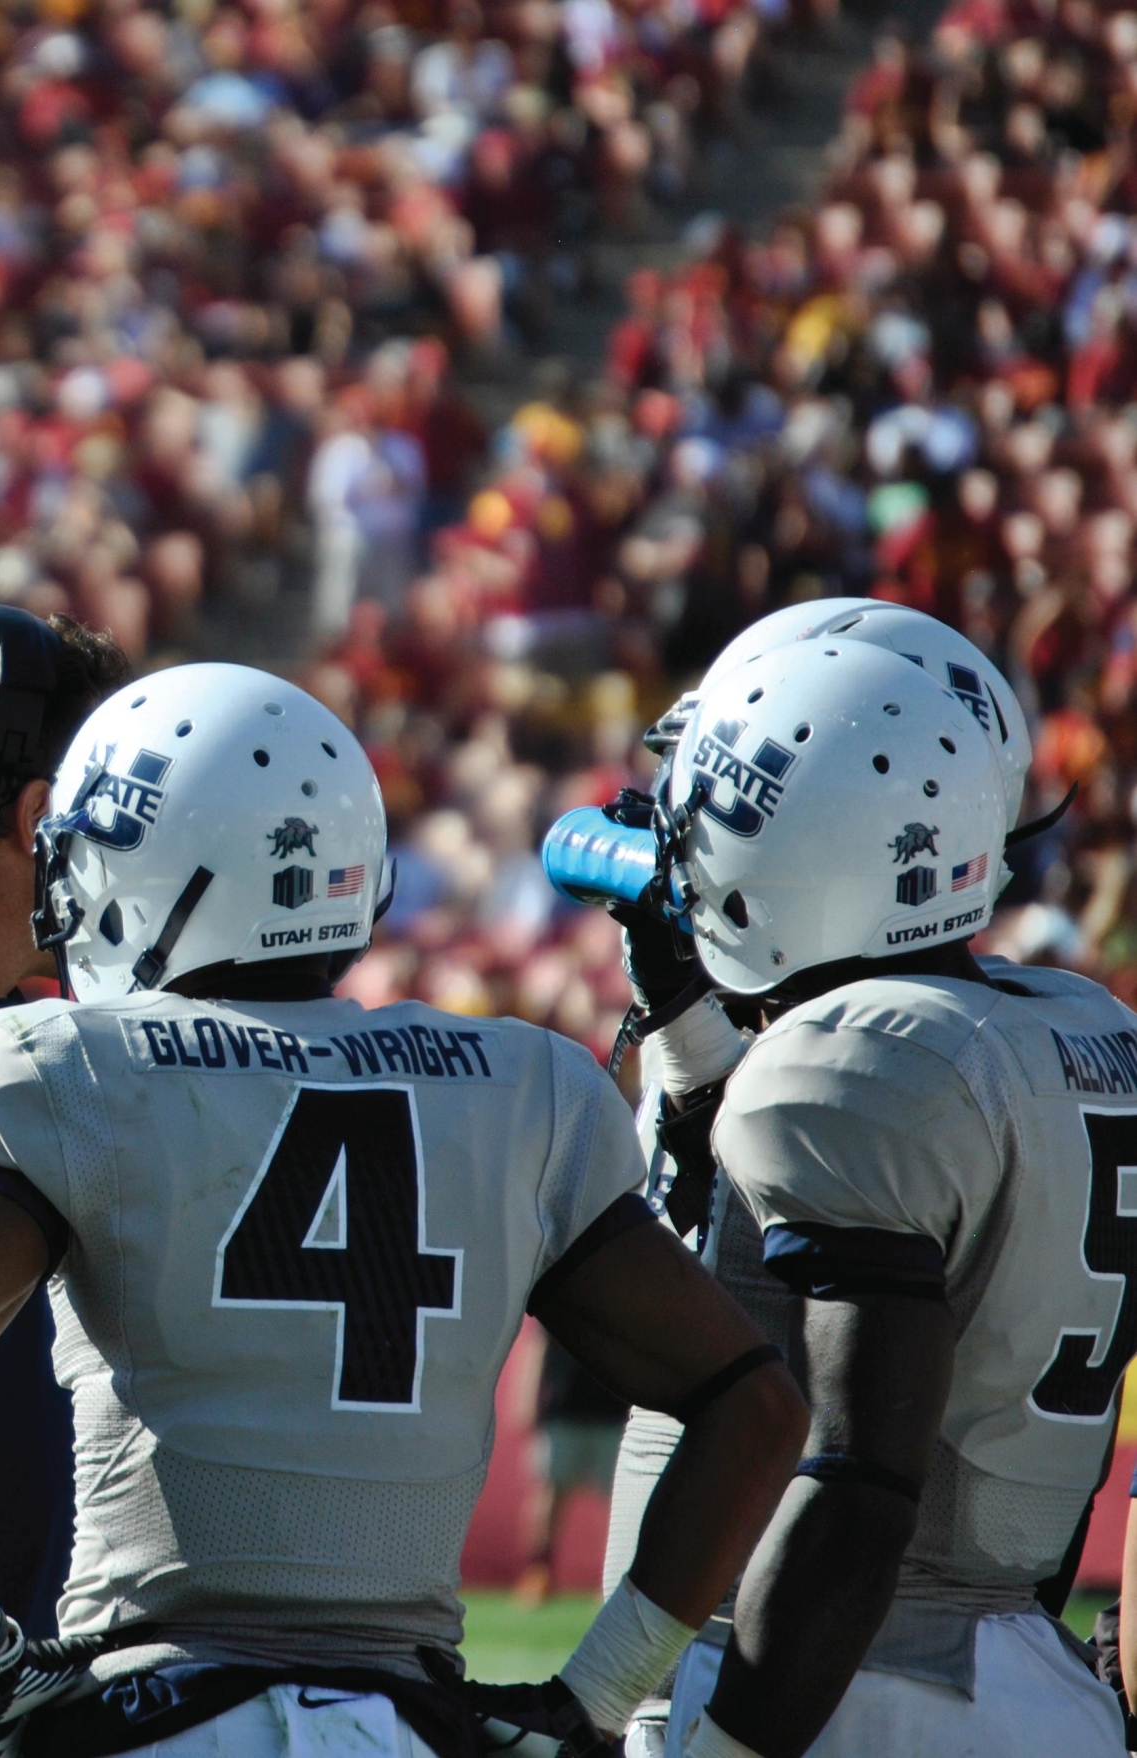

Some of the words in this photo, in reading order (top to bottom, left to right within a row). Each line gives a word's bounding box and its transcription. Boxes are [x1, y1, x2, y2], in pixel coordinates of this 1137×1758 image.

[92, 772, 165, 826] ATE
[693, 734, 785, 819] STATE
[261, 928, 312, 948] UTAH
[886, 922, 938, 945] UTAH
[141, 1018, 492, 1078] GLOVER-WRIGHT
[211, 1081, 464, 1414] 4
